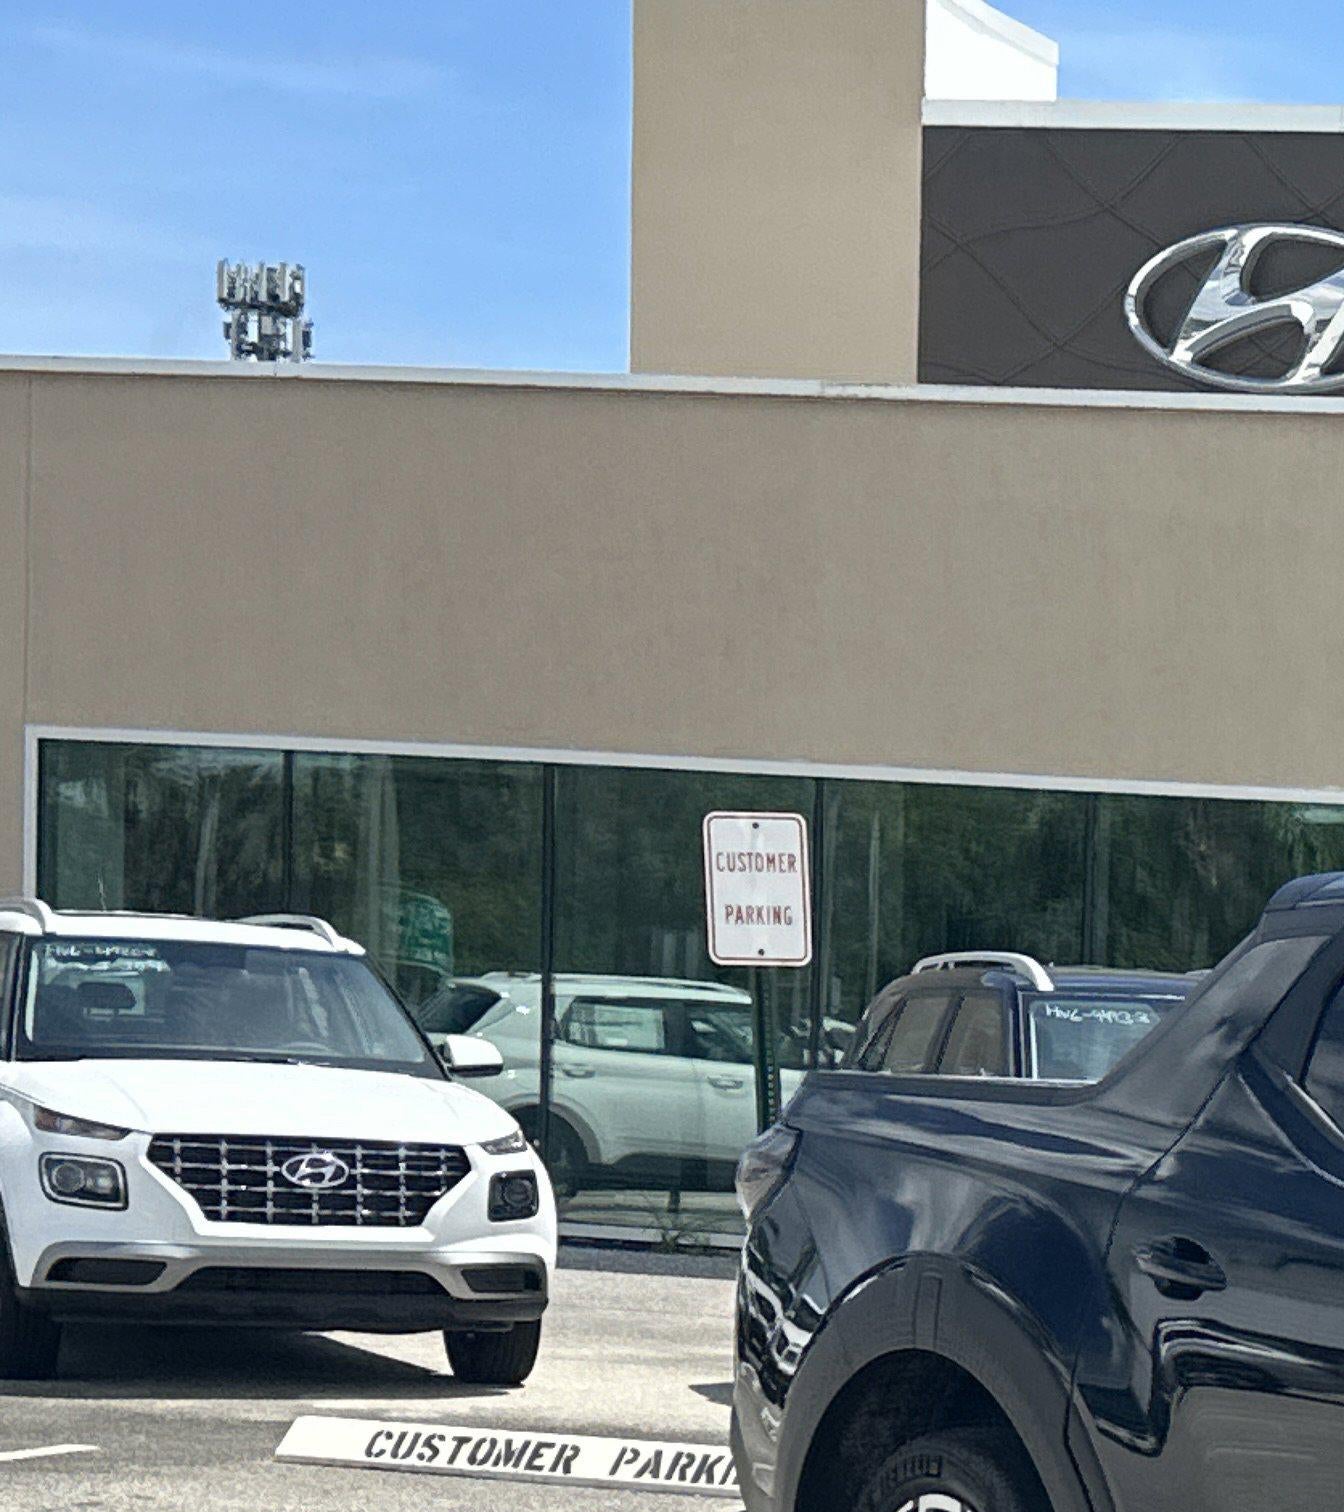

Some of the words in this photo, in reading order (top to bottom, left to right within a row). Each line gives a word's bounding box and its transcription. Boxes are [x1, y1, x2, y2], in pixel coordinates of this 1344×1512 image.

[716, 852, 798, 873] CUSTOMER
[724, 904, 793, 926] PARKING
[364, 1429, 582, 1475] CUSTOMER
[608, 1446, 738, 1486] PARKI
